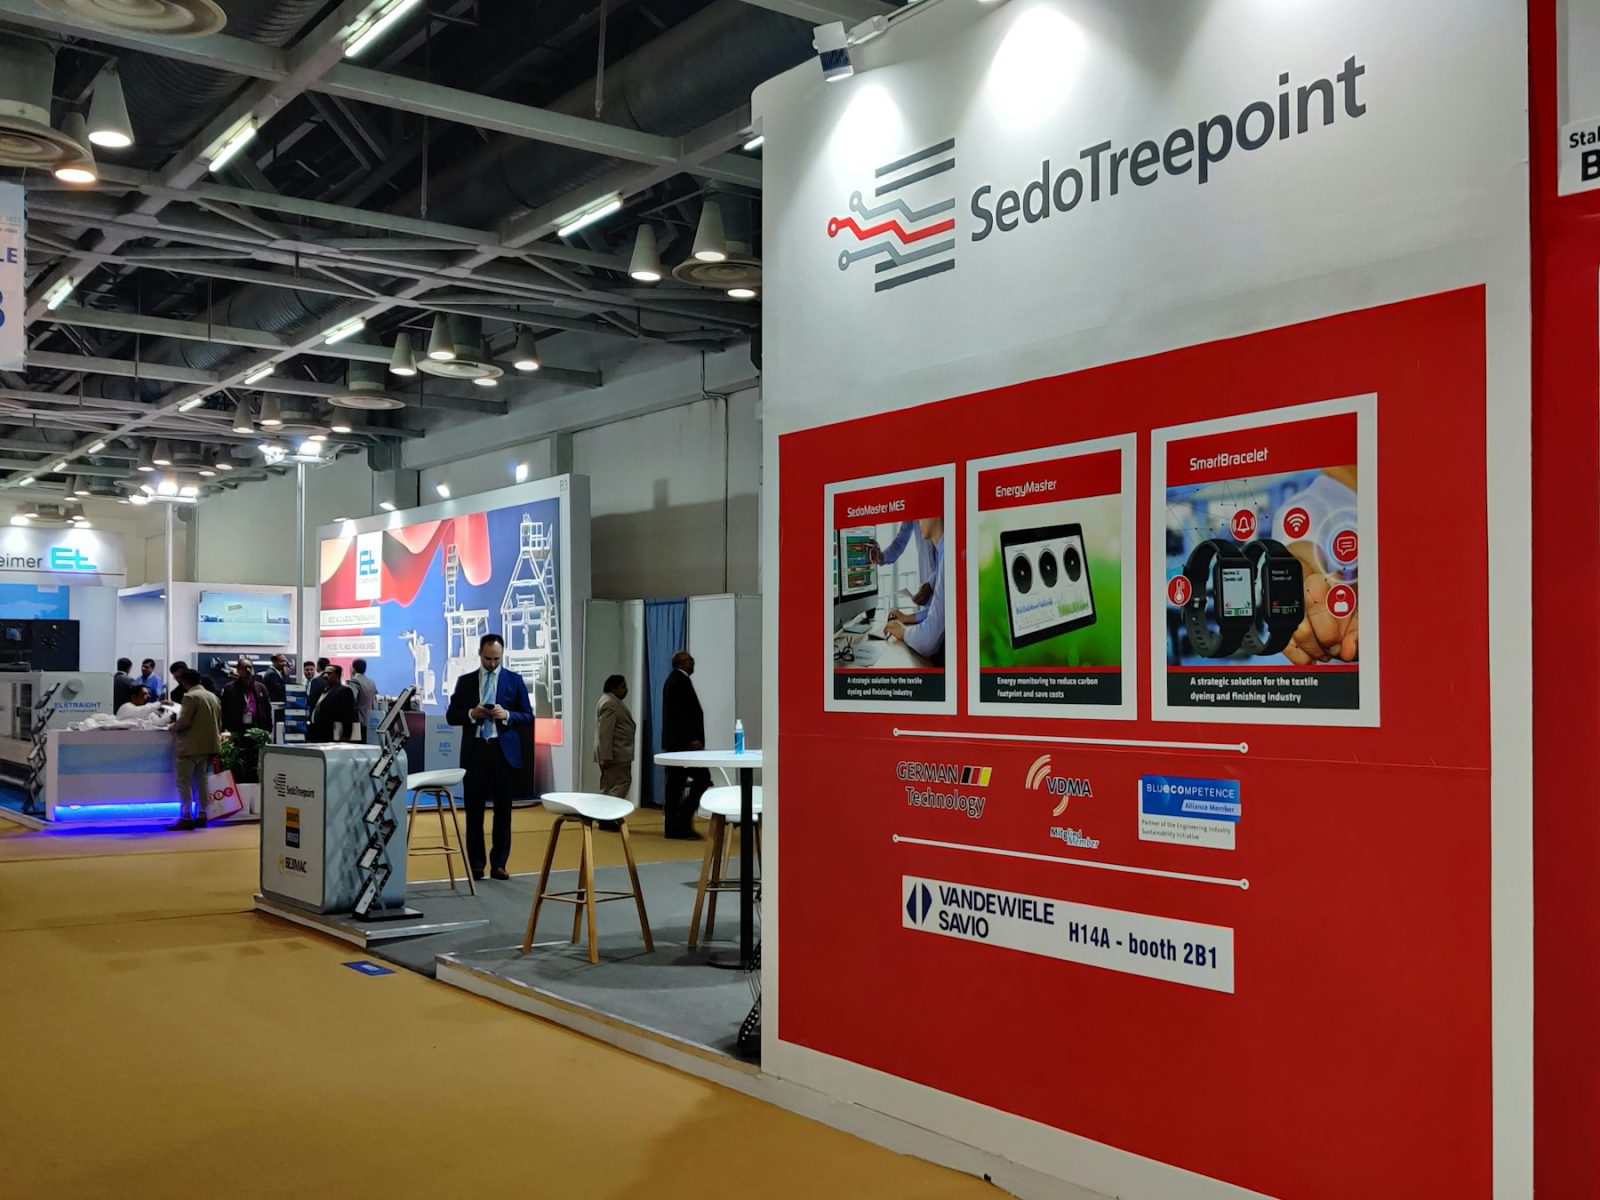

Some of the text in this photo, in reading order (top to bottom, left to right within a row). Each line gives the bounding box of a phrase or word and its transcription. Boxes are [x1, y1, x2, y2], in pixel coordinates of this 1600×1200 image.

[970, 55, 1366, 241] SedoTreepoint
[1189, 447, 1269, 471] SmartBracelet
[995, 480, 1057, 497] EnergyMaster
[847, 500, 905, 517] SedoMaster MES
[997, 677, 1016, 686] Energy
[1017, 677, 1049, 686] monitoring
[1057, 677, 1076, 685] reduce
[1077, 677, 1098, 685] carbon
[1190, 677, 1318, 687] A strategic solution for the textile
[997, 689, 1022, 698] footprint
[1023, 690, 1034, 698] and
[1190, 691, 1301, 703] dyeing and finishing industry
[896, 761, 958, 784] GERMAN
[1045, 776, 1093, 797] VDMA
[905, 786, 986, 818] Technology
[1209, 803, 1235, 812] Member
[938, 885, 1055, 925] VANDEWIELE
[938, 910, 989, 938] SAVIO
[1068, 921, 1111, 949] H14A
[1128, 933, 1177, 961] booth
[1183, 942, 1217, 969] 2B1
